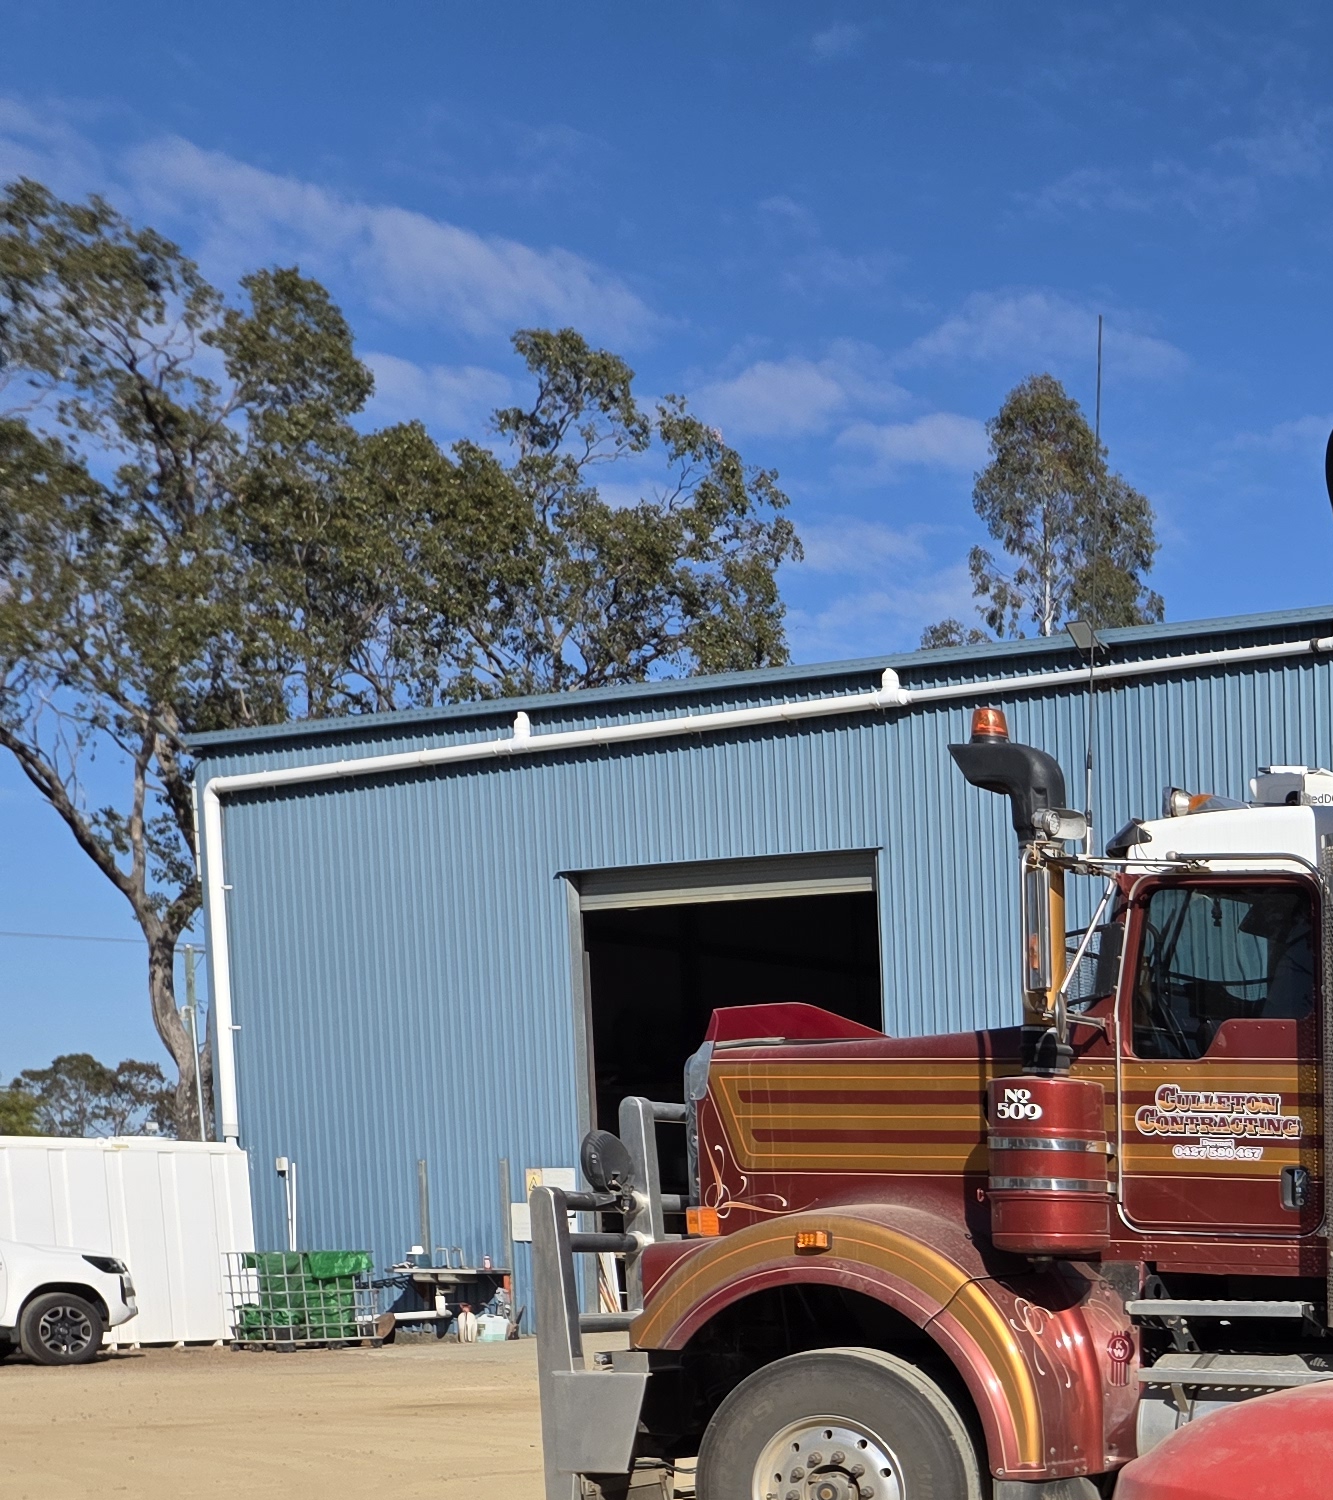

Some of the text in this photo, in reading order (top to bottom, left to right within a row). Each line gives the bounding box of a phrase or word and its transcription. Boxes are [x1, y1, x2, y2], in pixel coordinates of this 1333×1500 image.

[996, 1102, 1043, 1120] 509
[1156, 1085, 1280, 1115] CULLETON
[1136, 1106, 1301, 1138] CONTRACTING
[1174, 1147, 1207, 1158] 0427
[1235, 1148, 1262, 1159] 467
